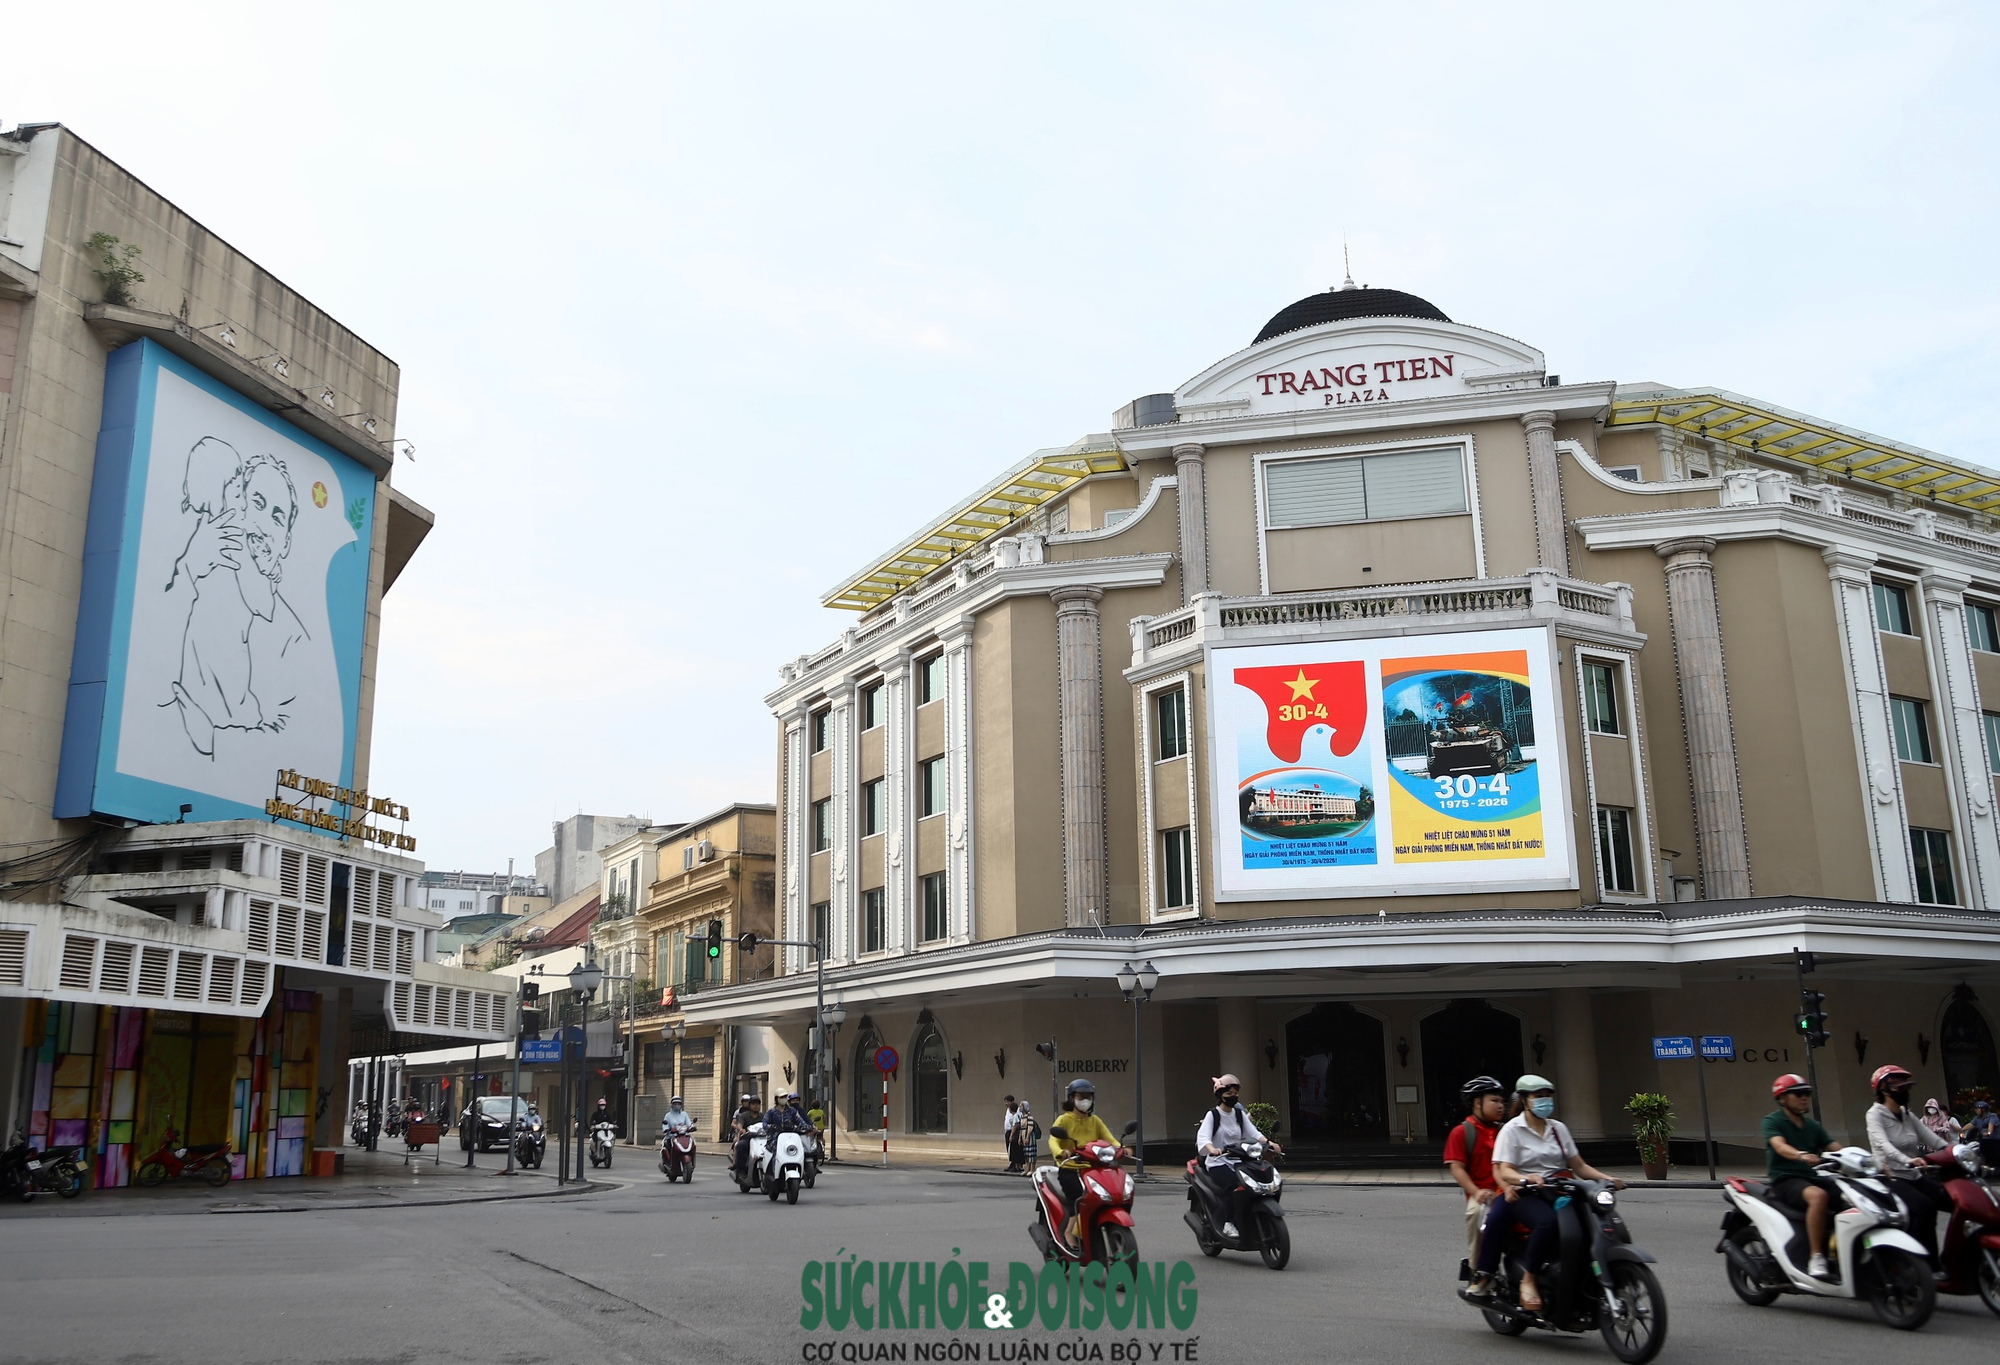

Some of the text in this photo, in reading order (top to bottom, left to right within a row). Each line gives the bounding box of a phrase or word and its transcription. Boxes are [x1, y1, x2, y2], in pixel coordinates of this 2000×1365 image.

[1256, 355, 1454, 395] TRANG TIEN
[1324, 388, 1389, 405] PLAZA
[1278, 703, 1329, 722] 30-4
[1434, 772, 1511, 799] 30-4
[1439, 799, 1469, 809] 1975
[1478, 797, 1508, 807] 2026
[399, 806, 410, 821] TA
[1424, 828, 1510, 841] NHIỆT LIỆT CHÀO MỪNG 51 NĂM
[1395, 844, 1410, 854] NGÀY
[1412, 842, 1423, 853] GIẢI
[1424, 843, 1443, 853] PHÒNG
[1460, 843, 1475, 852] NAM,
[1476, 840, 1495, 851] THỐNG
[1496, 839, 1511, 850] NHẤT
[1512, 838, 1523, 849] ĐẤT
[1702, 1045, 1731, 1054] HÀNG BÀI
[1058, 1059, 1129, 1073] BURBERRY
